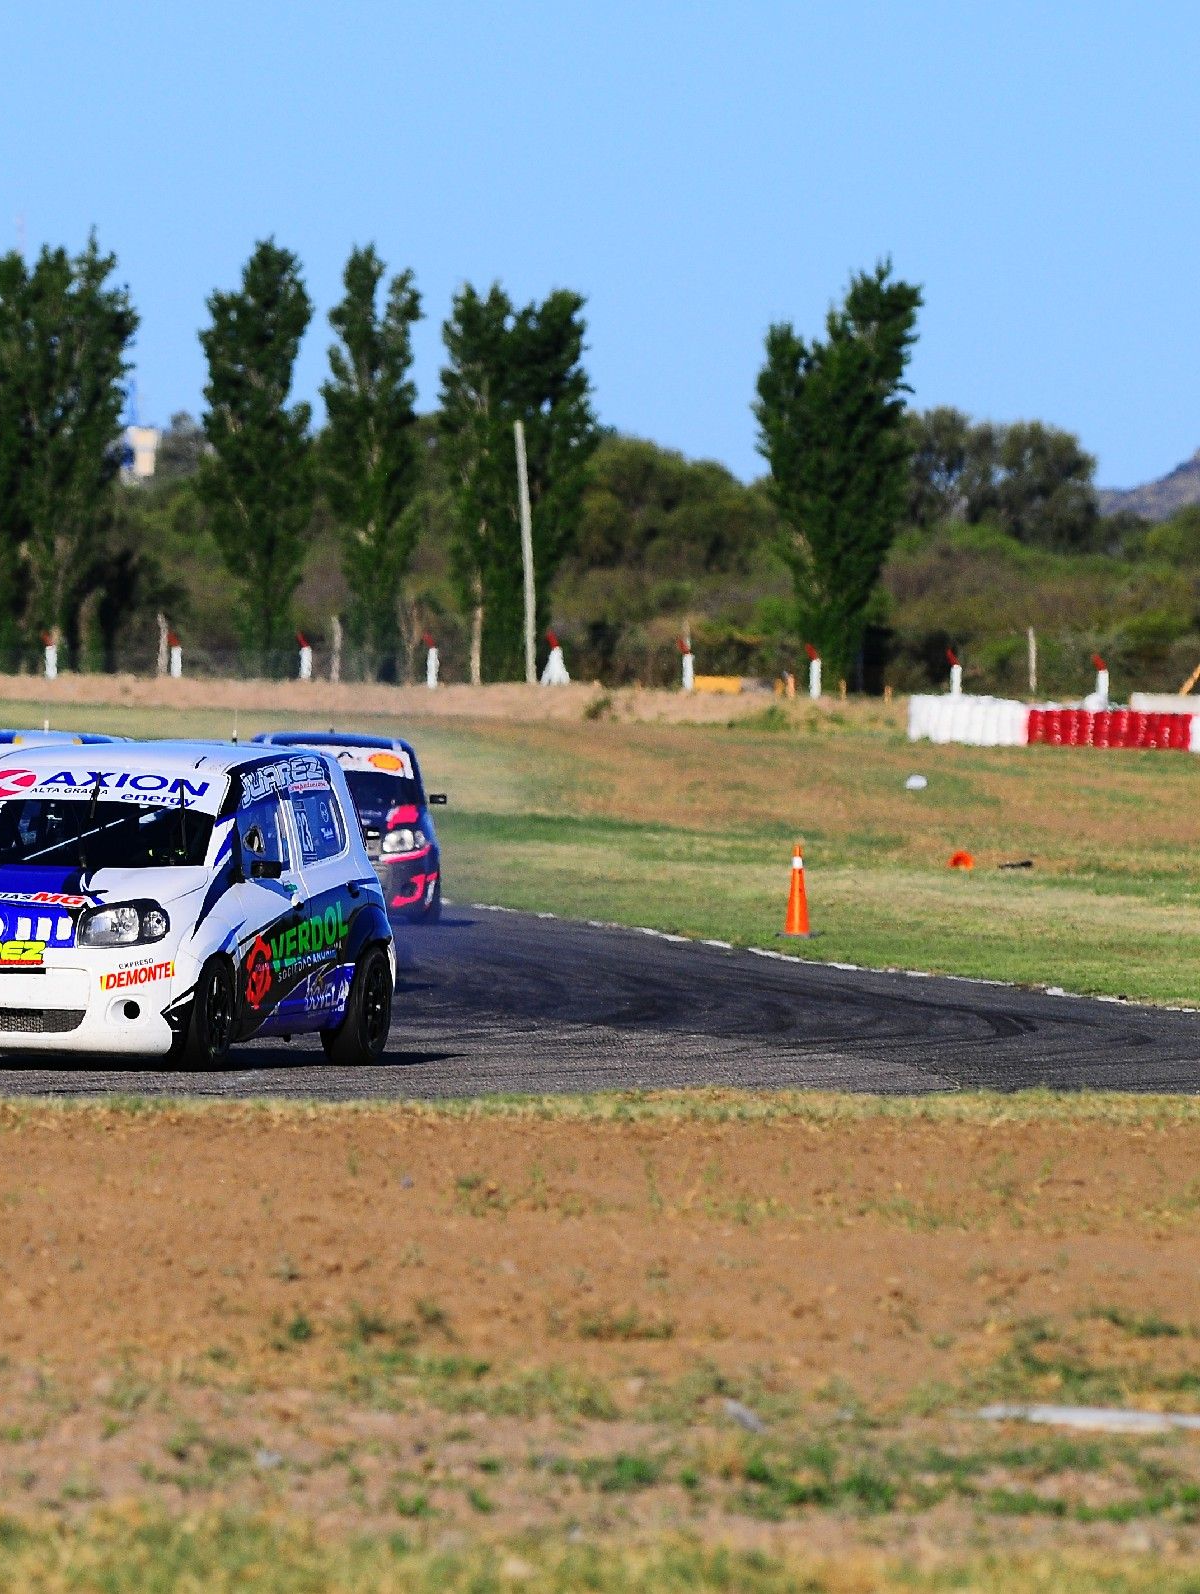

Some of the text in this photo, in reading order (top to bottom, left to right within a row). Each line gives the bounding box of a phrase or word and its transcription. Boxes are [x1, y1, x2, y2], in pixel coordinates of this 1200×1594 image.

[38, 771, 210, 797] AXION
[240, 756, 326, 809] JUAREZ
[120, 793, 196, 808] energy
[30, 892, 85, 905] MG
[270, 900, 349, 960] VERDOL
[105, 961, 171, 990] DEMONTE
[118, 957, 154, 970] EXPRESO
